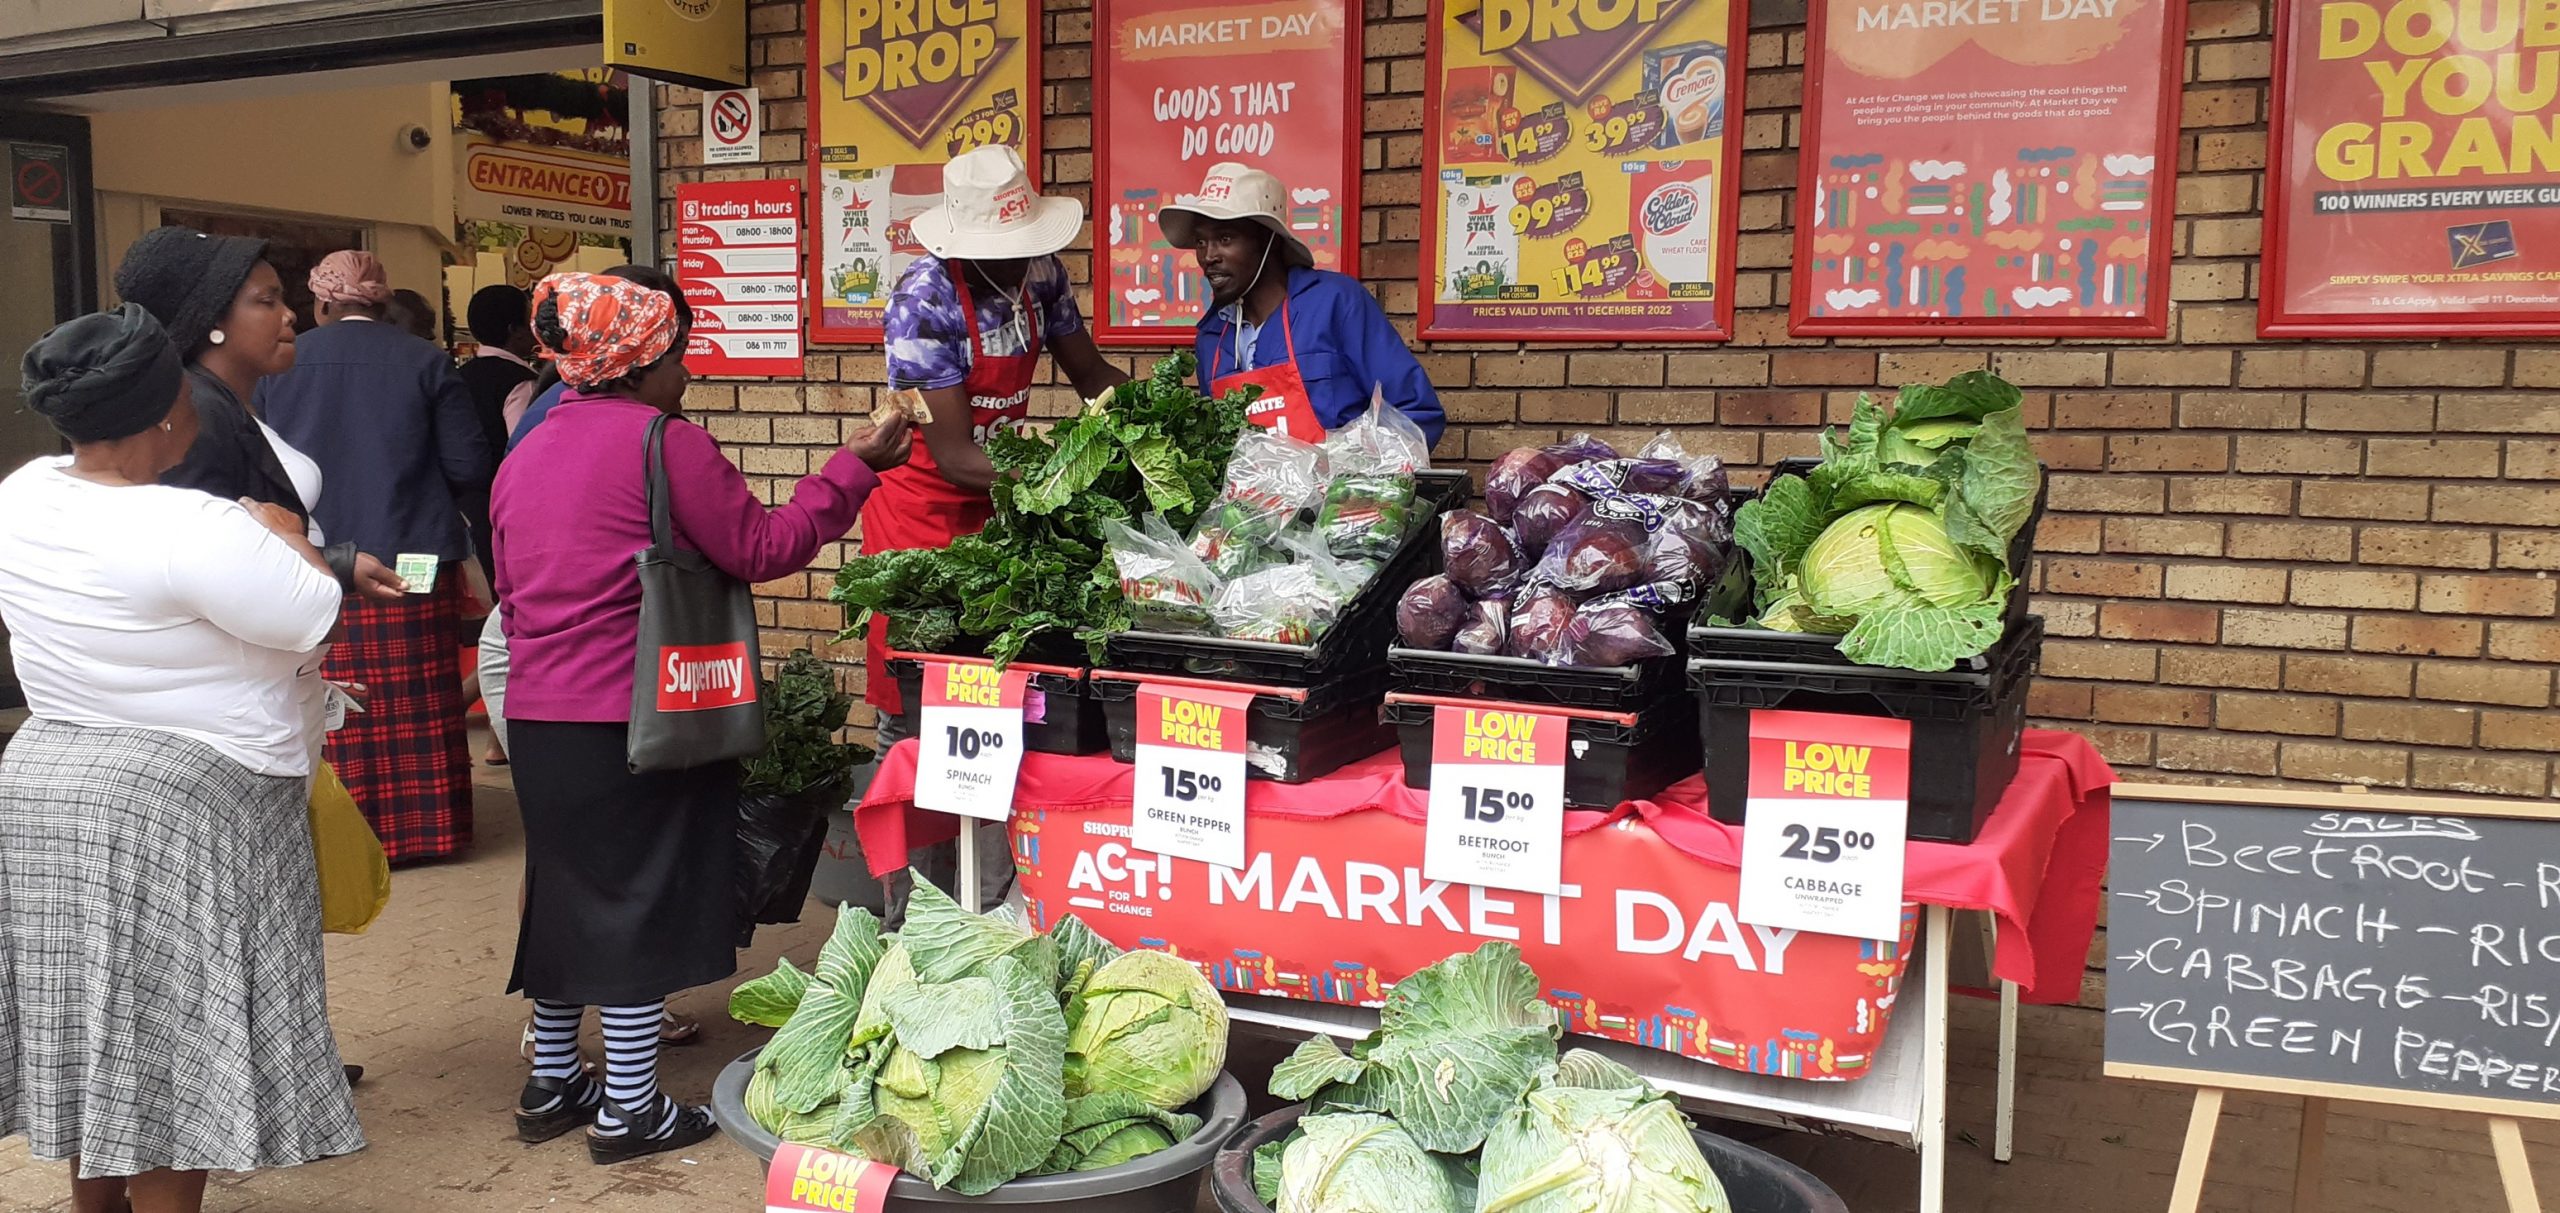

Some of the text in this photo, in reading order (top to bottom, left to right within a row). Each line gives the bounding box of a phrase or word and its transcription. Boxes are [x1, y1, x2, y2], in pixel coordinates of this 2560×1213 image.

[1856, 0, 2118, 32] MARKET DAY
[1135, 12, 1317, 49] MARKET DAY
[2319, 0, 2560, 60] DOUB
[844, 23, 997, 100] DROP
[1666, 74, 1716, 103] Cremora
[1846, 97, 1857, 105] At
[1859, 95, 1874, 104] Act
[1876, 94, 1890, 103] for
[1892, 93, 1928, 104] Change
[1947, 91, 1967, 100] love
[1969, 88, 2027, 100] showcasing
[2029, 87, 2046, 96] the
[2048, 87, 2069, 96] cool
[2071, 85, 2104, 97] things
[2106, 84, 2128, 94] that
[2364, 52, 2560, 117] YOU
[1153, 81, 1296, 121] GOODS THAT
[1853, 96, 2119, 116] people are doing in your community. At Market Day we
[982, 110, 993, 118] FOR
[1857, 107, 2113, 127] bring you the people behind the goods that do good.
[1181, 121, 1275, 160] DO GOOD
[1476, 135, 1492, 144] OR
[2315, 115, 2560, 181] GRAN
[1441, 171, 1463, 180] 10kg
[1623, 163, 1646, 173] 10kg
[475, 160, 592, 198] ENTRANCE
[701, 200, 793, 218] trading hours
[999, 194, 1031, 221] ACT!
[1647, 190, 1690, 226] Golden
[2320, 188, 2535, 211] 100 WINNERS EVERY WEEK
[502, 205, 607, 227] LOWER PRICES YOU CAN
[842, 217, 870, 228] STAR
[843, 210, 868, 218] WHITE
[1654, 203, 1695, 232] Cloud
[682, 226, 793, 236] mon 08h00 18h00
[1467, 221, 1495, 231] STAR
[682, 235, 714, 246] thursday
[1662, 246, 1707, 255] WHEAT FLOUR
[1690, 239, 1707, 247] CAKE
[682, 258, 704, 270] friday
[2329, 272, 2535, 285] SIMPLY SWIPE YOUR XTRA SAVINGS
[683, 284, 797, 298] saturday 08h00 17h00
[2440, 295, 2466, 305] Valid
[2504, 294, 2558, 304] December
[738, 313, 794, 322] 08h00 15h00
[847, 310, 873, 319] PRICES
[1473, 304, 1673, 316] PRICES VALID UNTIL 11 DECEMBER 2022
[746, 341, 787, 350] 086 111 7117
[917, 410, 926, 419] 20
[664, 651, 743, 704] Supermy
[946, 662, 1001, 688] LOW
[946, 682, 1001, 707] PRICE
[1161, 696, 1223, 730] LOW
[1161, 720, 1223, 751] PRICE
[1465, 710, 1537, 742] LOW
[1463, 735, 1536, 764] PRICE
[1785, 741, 1872, 774] LOW
[946, 768, 992, 786] SPINACH
[1784, 767, 1872, 799] PRICE
[1083, 820, 1133, 838] SHOPRI
[1147, 808, 1232, 834] GREEN PEPPER
[2310, 812, 2476, 836] SALES
[1458, 834, 1530, 854] BEETROOT
[1482, 852, 1506, 860] BUNCH
[1108, 890, 1131, 902] FOR
[1784, 876, 1862, 897] CABBAGE
[1067, 842, 1799, 976] ACT! MARKET DAY
[1795, 893, 1844, 905] UNWRAPPED
[1108, 902, 1153, 918] CHANGE
[2155, 879, 2400, 943] SPINACH
[2146, 938, 2429, 1010] CABBAGE
[2148, 1000, 2362, 1063] GREEN
[796, 1149, 871, 1188] LOW
[791, 1176, 858, 1213] PRICE
